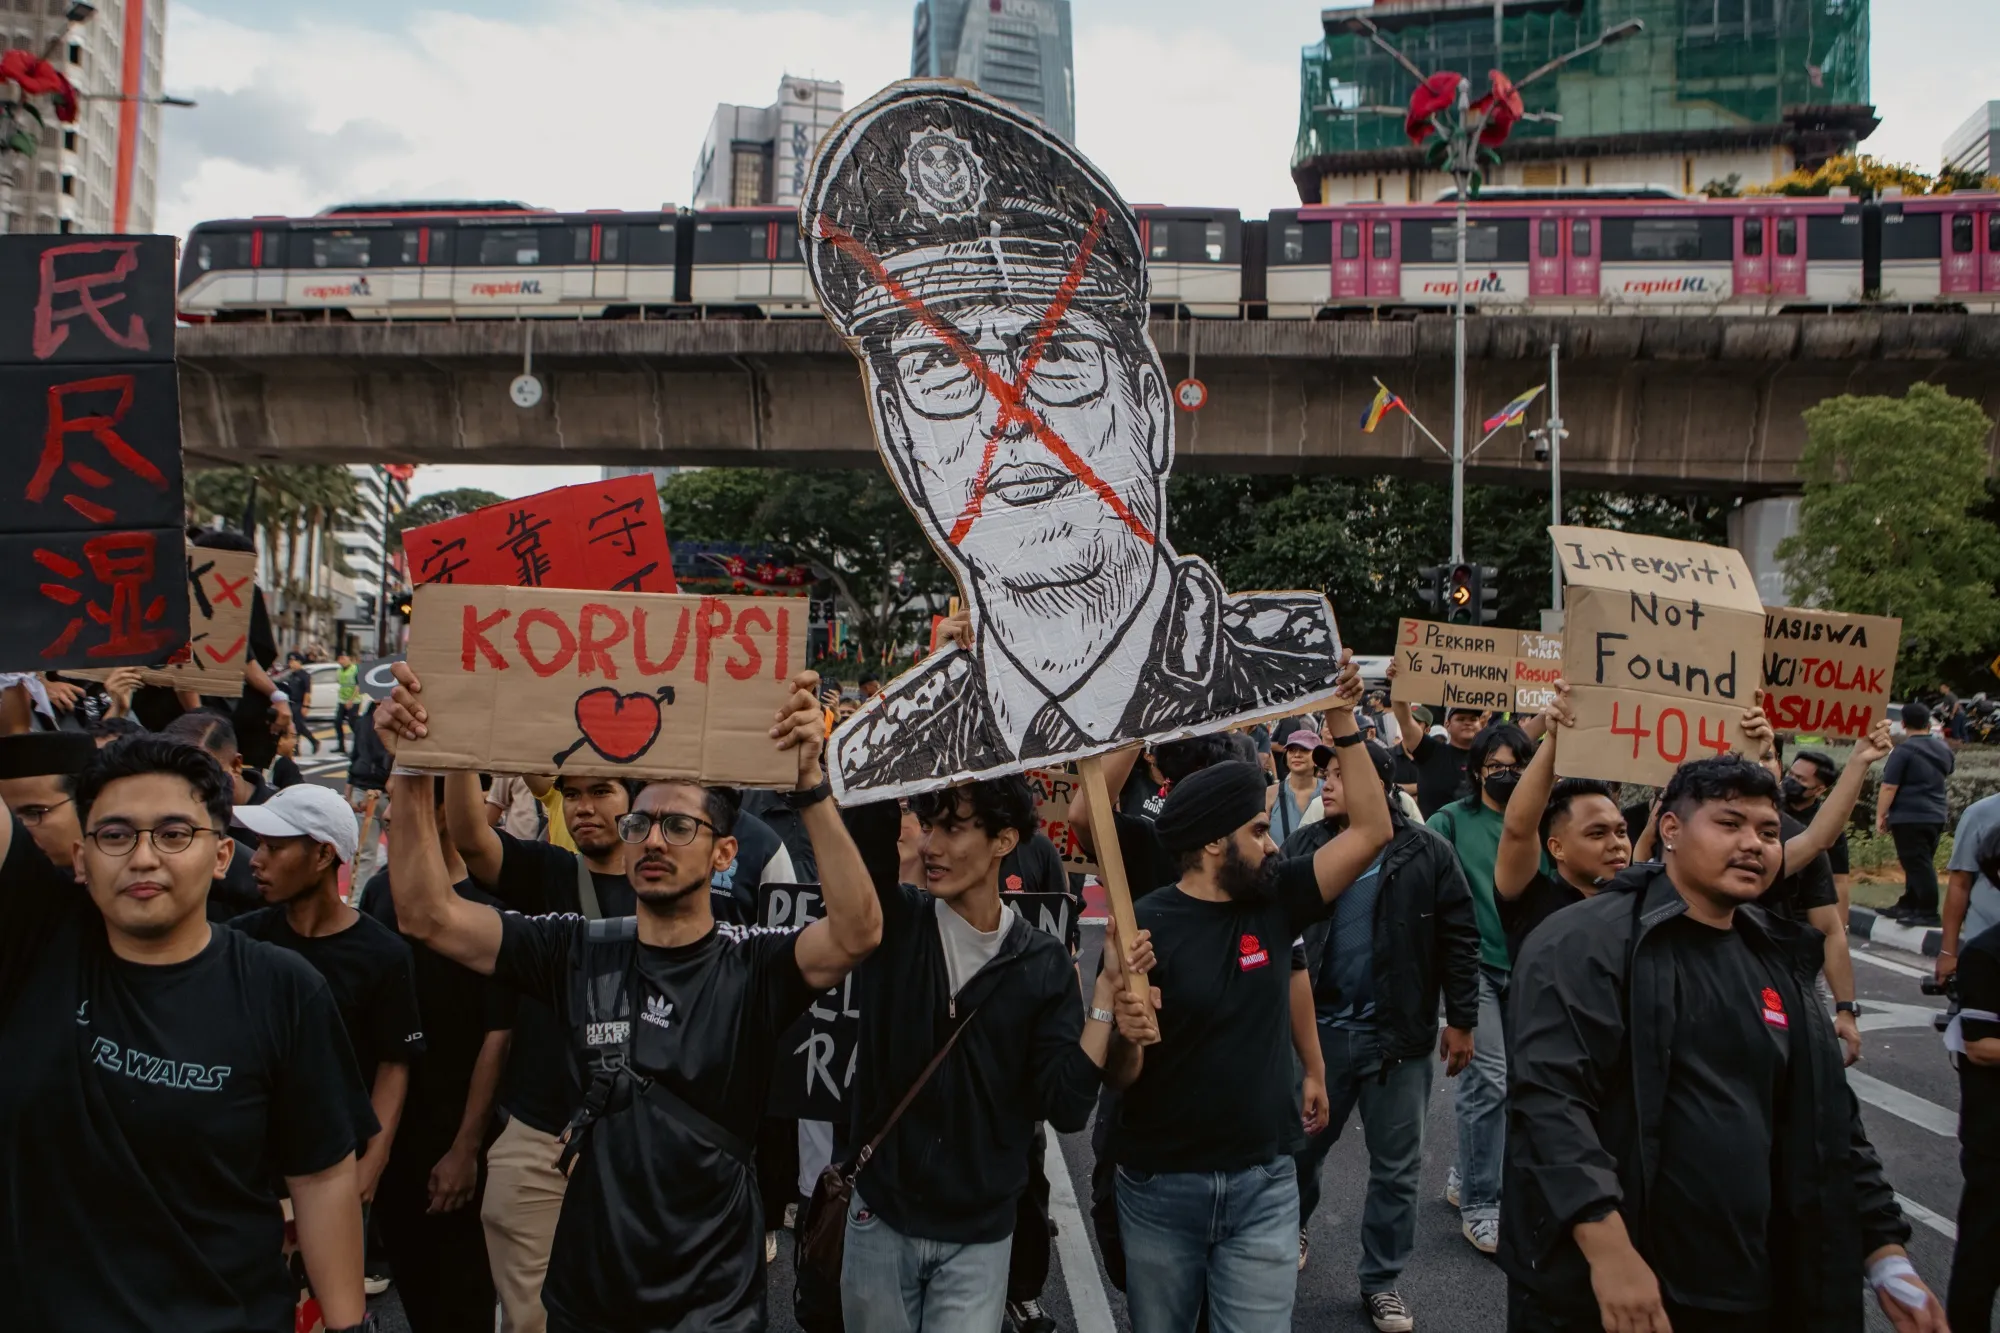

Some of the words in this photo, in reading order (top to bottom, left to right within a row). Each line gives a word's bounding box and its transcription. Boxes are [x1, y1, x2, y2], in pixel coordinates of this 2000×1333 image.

[791, 122, 808, 194] KWSP
[1624, 276, 1709, 295] rapidKL
[1565, 543, 1737, 590] Intergriti
[1630, 589, 1705, 630] Not
[461, 596, 790, 683] KORUPSI
[1402, 621, 1419, 646] 3
[1764, 614, 1868, 648] HASISWA
[1431, 654, 1508, 683] JATUHKAN
[1527, 648, 1561, 660] MASA
[1596, 632, 1736, 699] Found
[1801, 658, 1886, 694] TOLAK
[1446, 684, 1508, 708] NEGARA
[1610, 702, 1732, 763] 404
[586, 1021, 630, 1035] HYPER
[641, 1011, 670, 1029] adidas
[587, 1032, 624, 1046] GEAR
[125, 1048, 232, 1092] WARS
